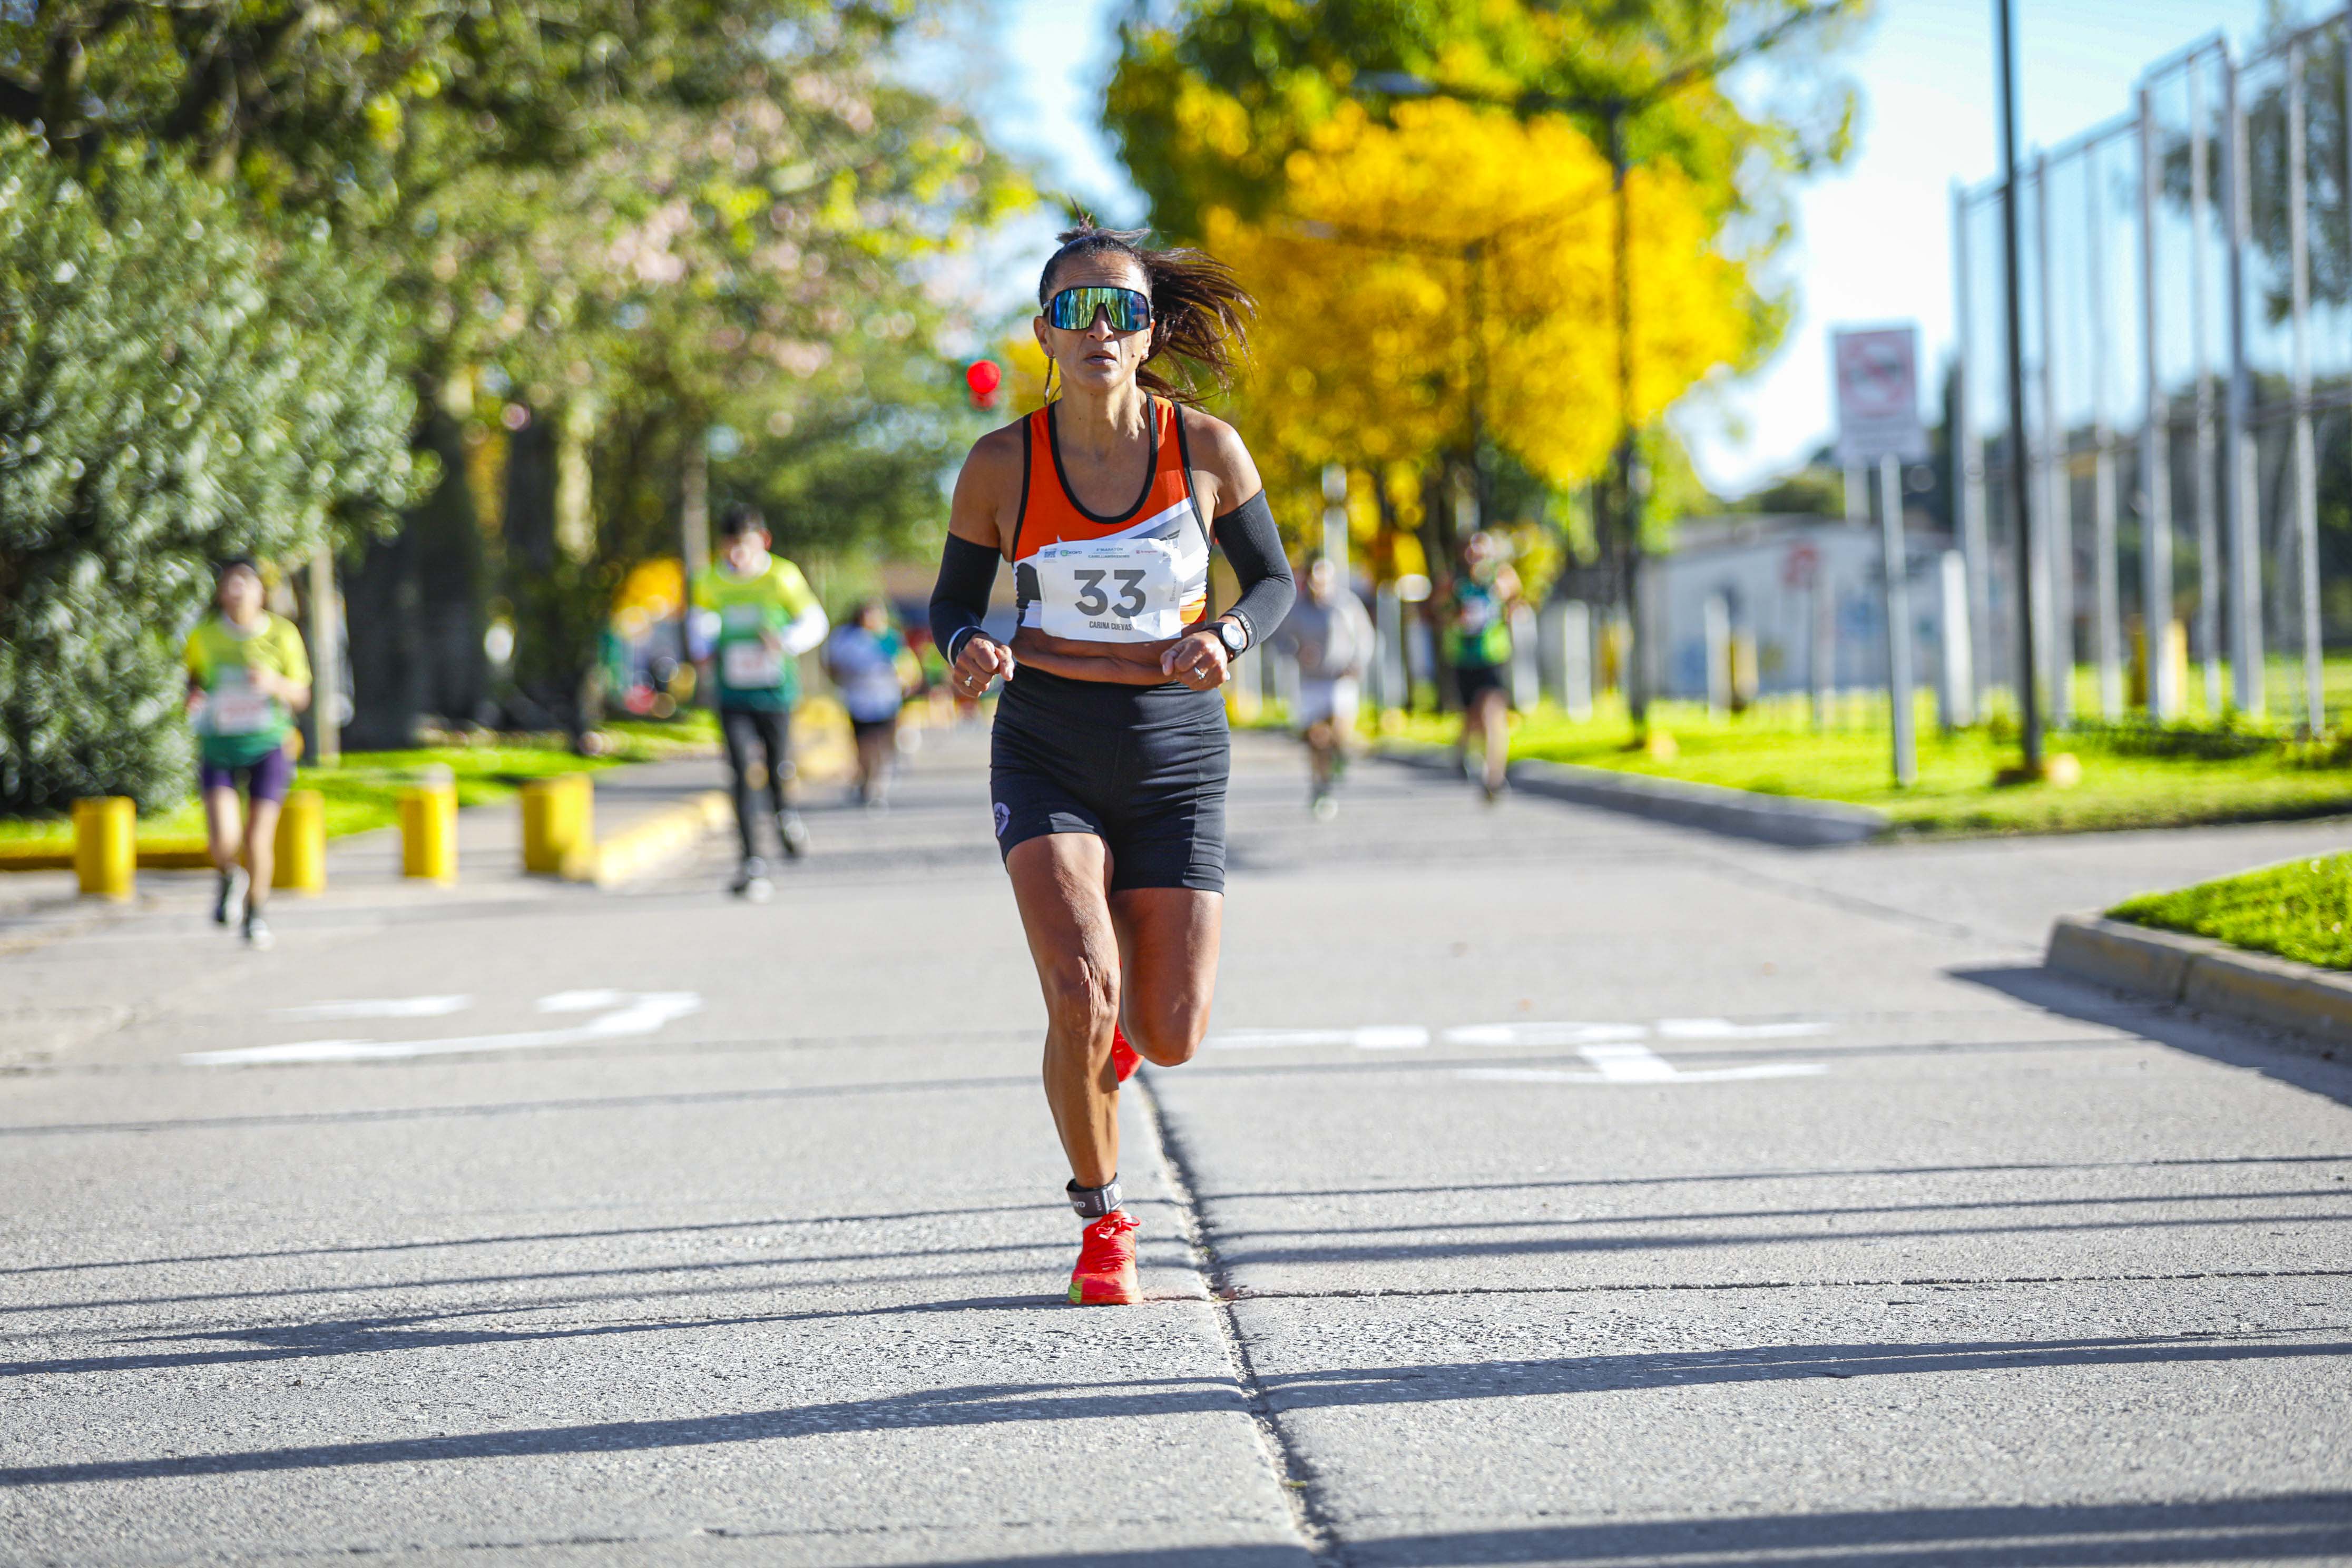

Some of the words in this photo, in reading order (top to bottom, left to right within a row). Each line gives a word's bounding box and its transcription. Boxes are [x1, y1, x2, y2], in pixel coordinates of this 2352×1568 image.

[1074, 570, 1146, 619] 33
[1089, 621, 1110, 629] CARINA
[1239, 612, 1252, 635] SOX
